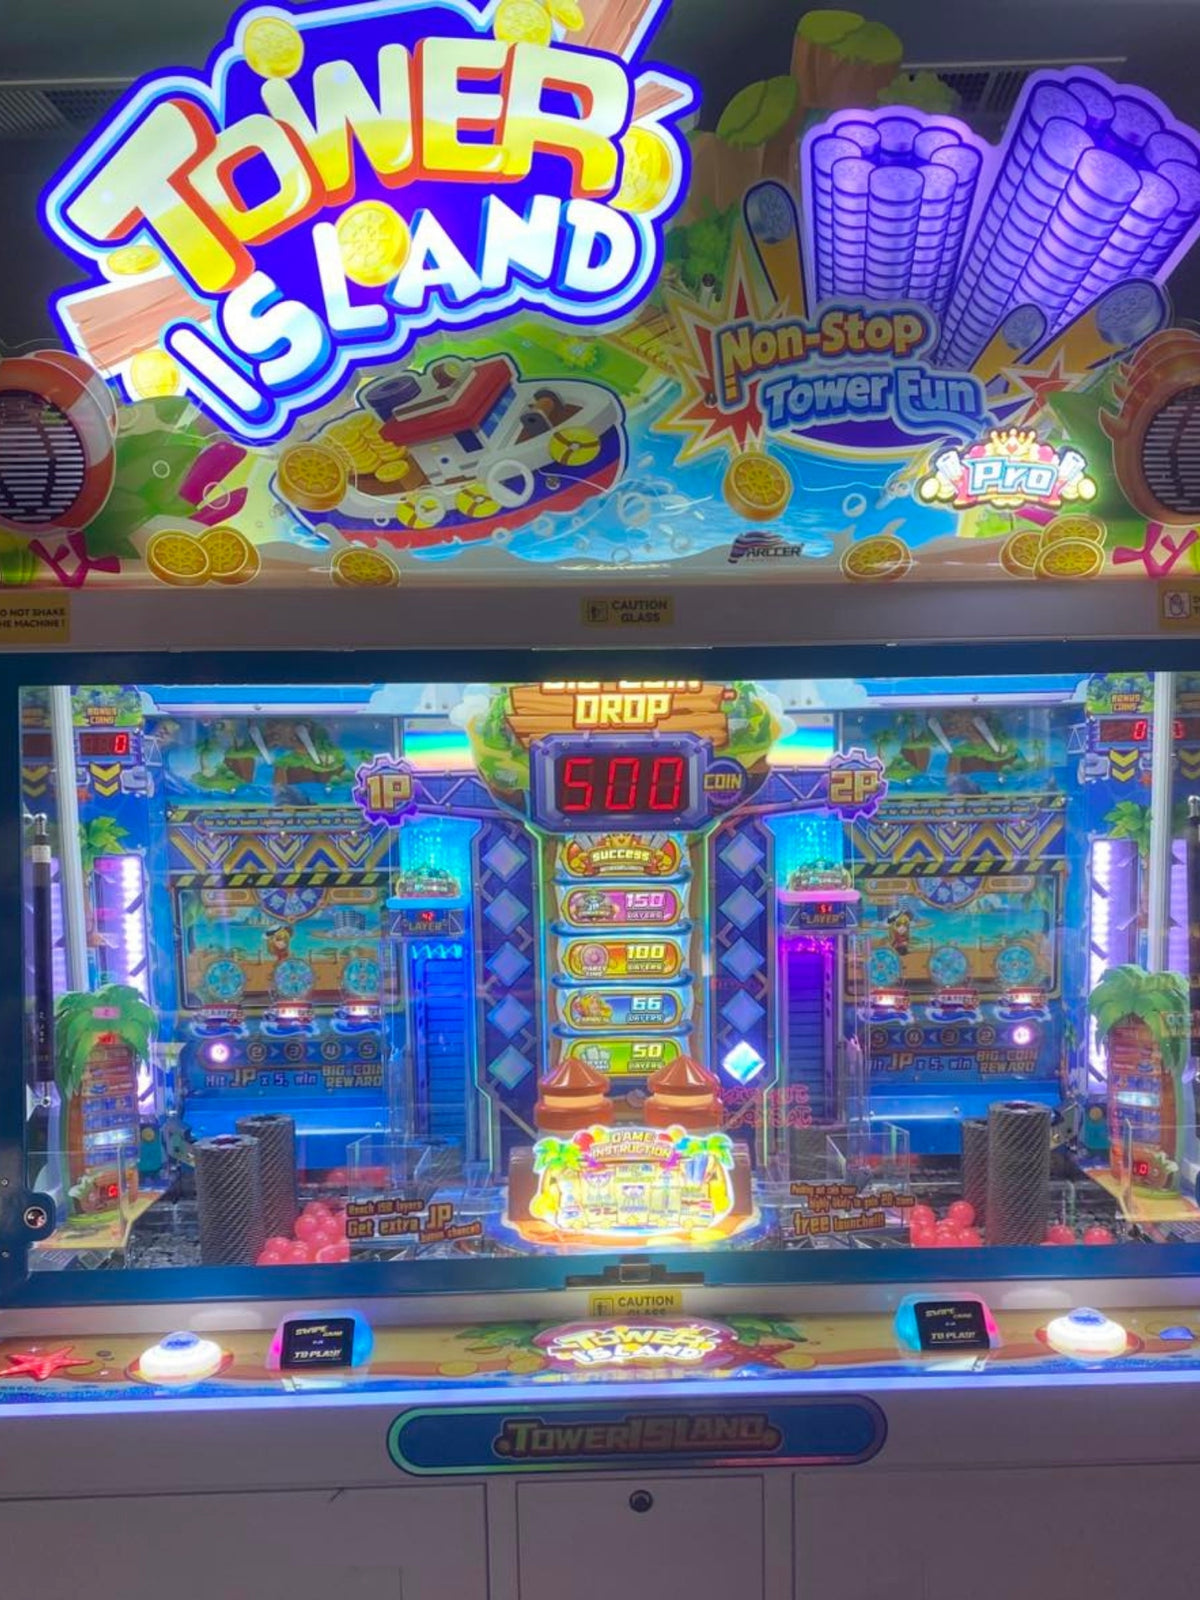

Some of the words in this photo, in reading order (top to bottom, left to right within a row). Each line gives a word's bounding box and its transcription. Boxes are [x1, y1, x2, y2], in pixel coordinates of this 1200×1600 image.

[66, 37, 630, 293] TOWER
[164, 194, 638, 416] ISLAND
[897, 370, 978, 416] Fun
[968, 459, 1058, 494] Pro
[9, 608, 30, 617] NOT
[32, 607, 66, 616] SHAKE
[612, 599, 668, 611] CAUTION
[14, 619, 59, 628] MACHINE
[620, 611, 661, 623] GLASS
[574, 693, 672, 725] DROP
[1132, 720, 1147, 741] 0
[114, 733, 127, 754] 0
[366, 773, 412, 811] 1P
[563, 757, 684, 811] 500
[703, 773, 742, 790] COIN
[828, 769, 880, 805] 2P
[625, 892, 665, 908] 150
[626, 945, 665, 959] 100
[632, 996, 663, 1011] 66
[632, 1042, 663, 1058] 50
[611, 1131, 653, 1143] GAME
[590, 1142, 672, 1158] INSTRUCTION
[347, 1219, 373, 1237] Get
[379, 1218, 419, 1234] extra
[427, 1204, 453, 1229] JP
[795, 1212, 830, 1234] free
[618, 1296, 674, 1307] CAUTION
[560, 1327, 706, 1350] TOWER
